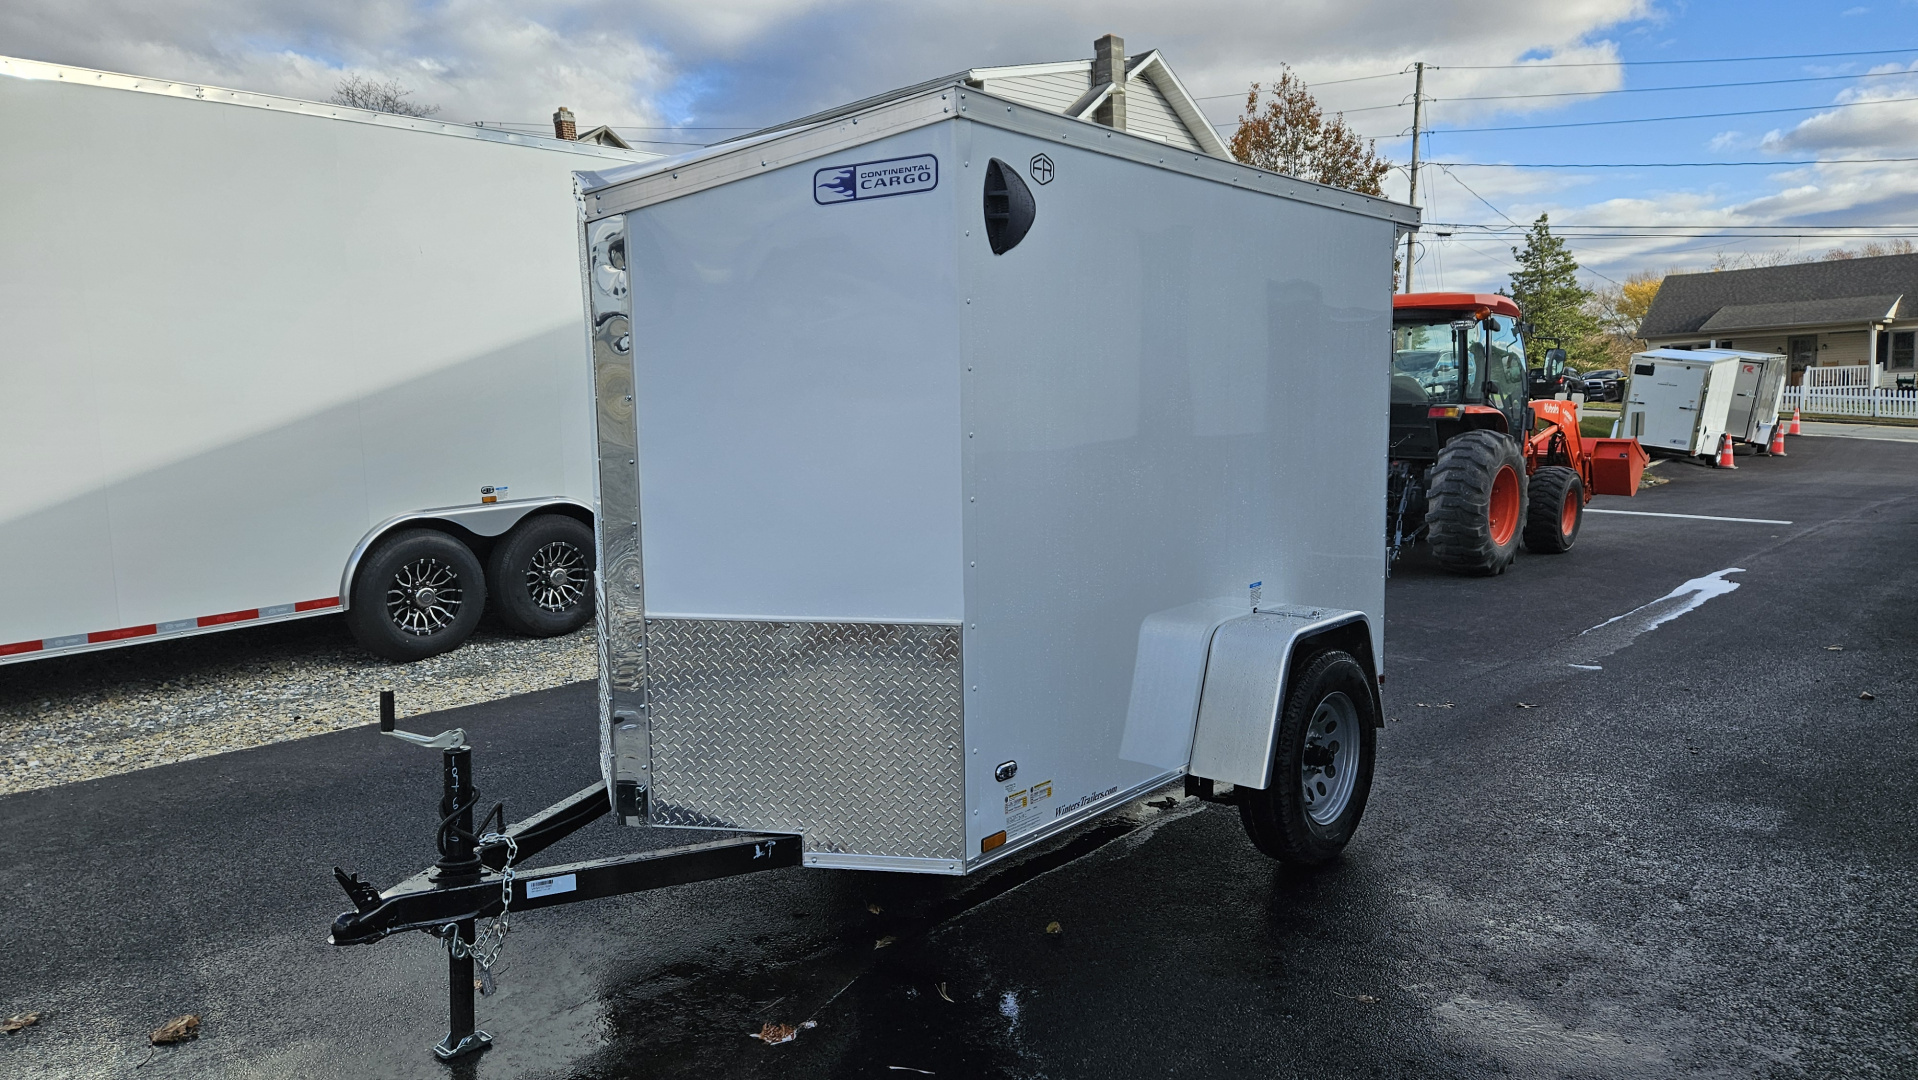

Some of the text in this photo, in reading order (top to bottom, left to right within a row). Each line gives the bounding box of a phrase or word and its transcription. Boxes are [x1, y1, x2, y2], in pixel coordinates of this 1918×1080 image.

[860, 164, 931, 179] CONTINENTAL
[860, 171, 931, 190] CARGO
[1055, 785, 1118, 818] WintersTrailers.com
